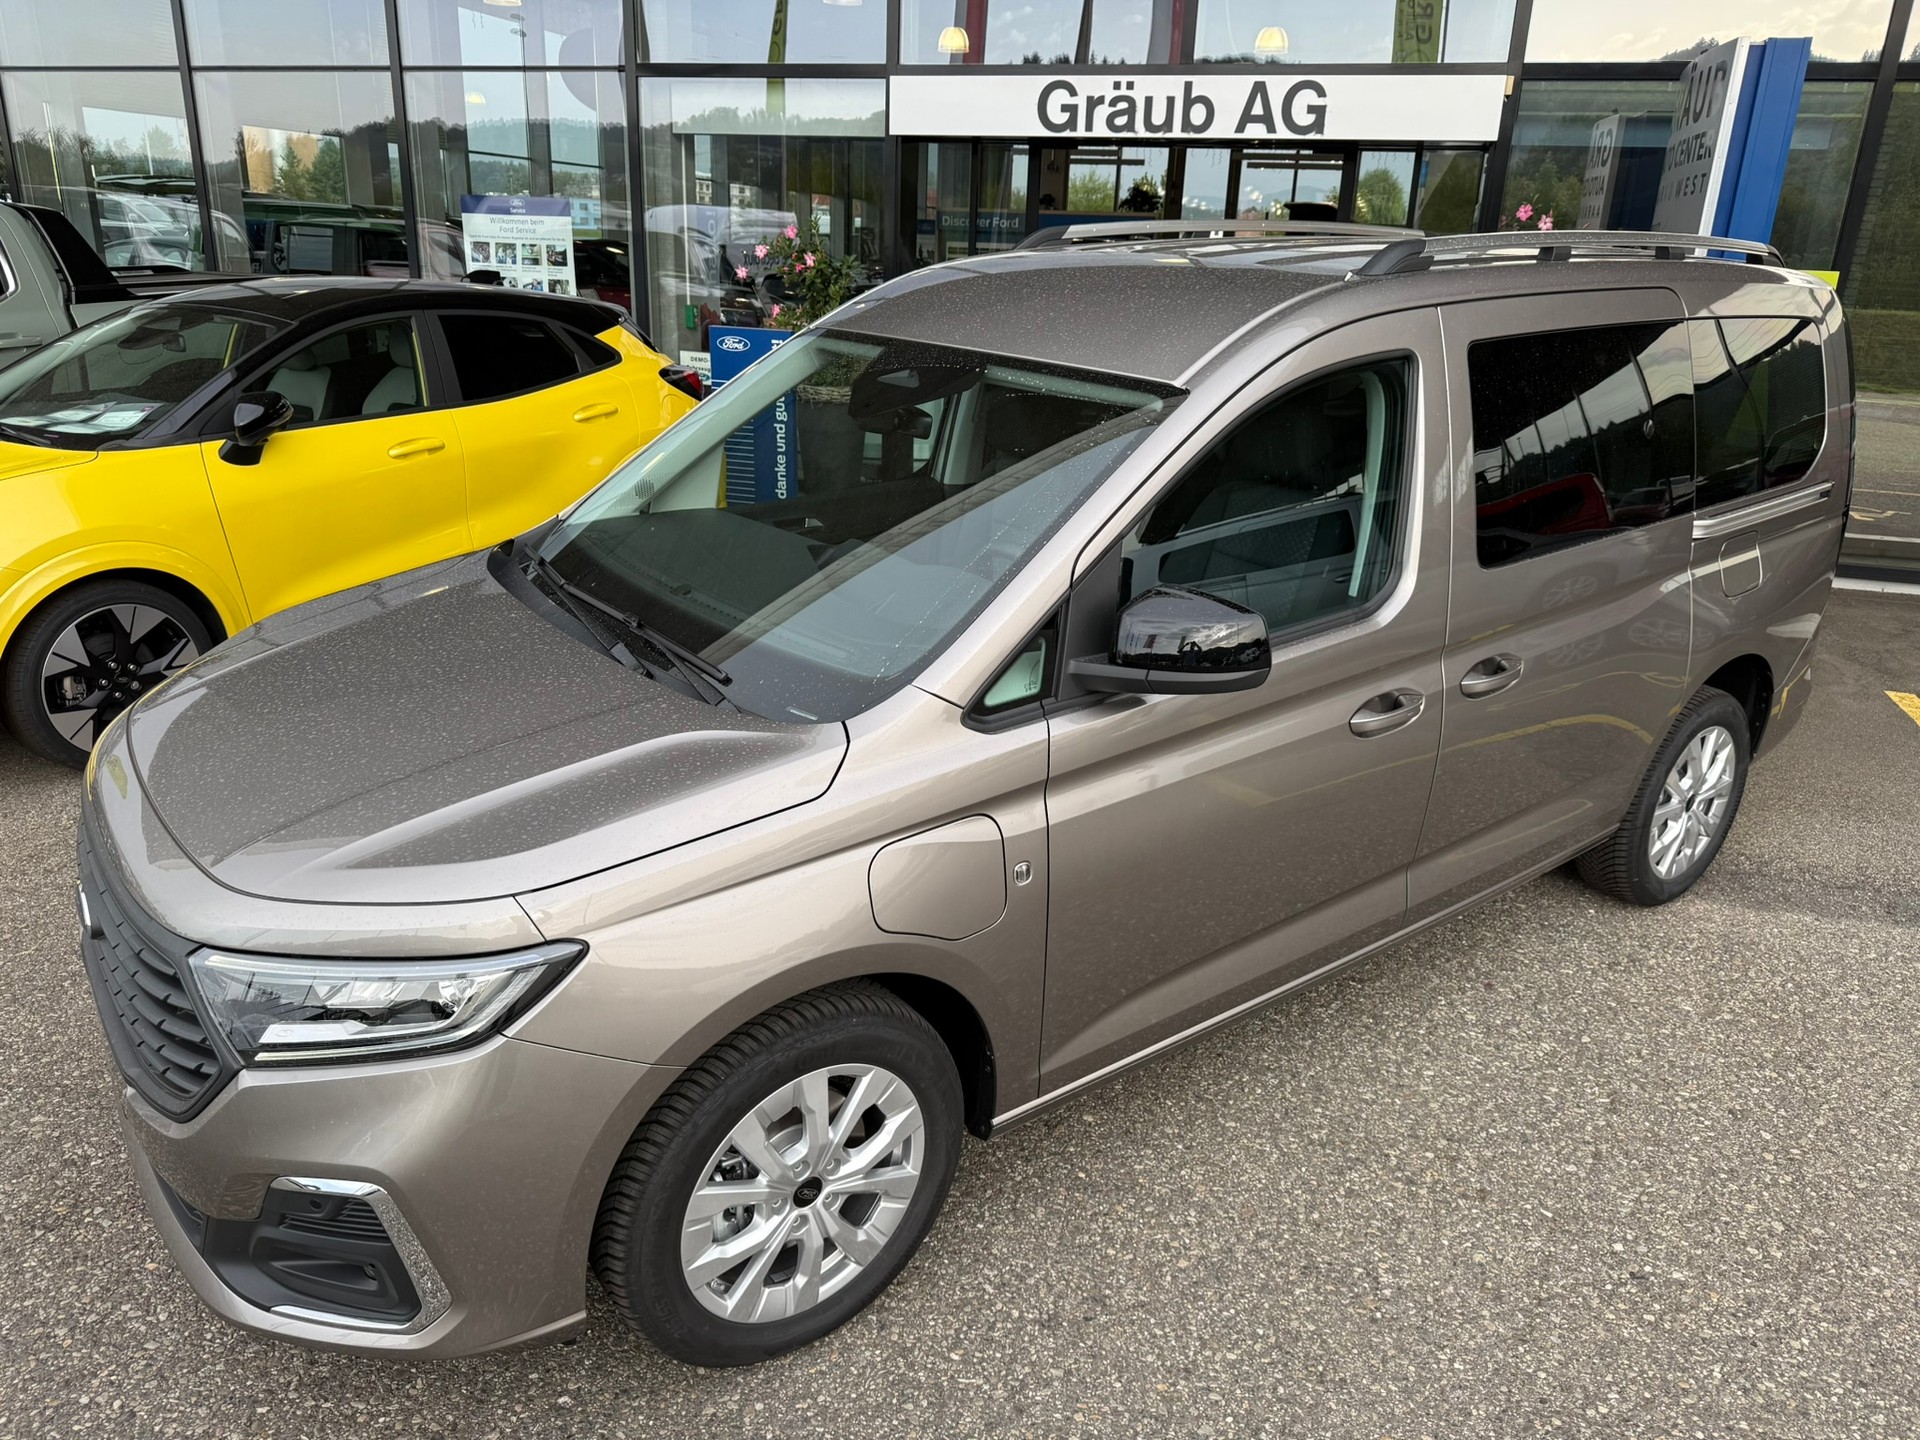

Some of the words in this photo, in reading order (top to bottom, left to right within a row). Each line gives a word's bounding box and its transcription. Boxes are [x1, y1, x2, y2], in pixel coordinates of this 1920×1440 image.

[1037, 79, 1215, 134] Gräub
[1234, 79, 1328, 136] AG
[489, 217, 529, 226] Willkommen
[530, 218, 545, 226] beim
[499, 226, 515, 234] Ford
[515, 227, 537, 235] Service
[992, 216, 1019, 228] Ford
[773, 424, 787, 452] und
[774, 455, 787, 499] danke
